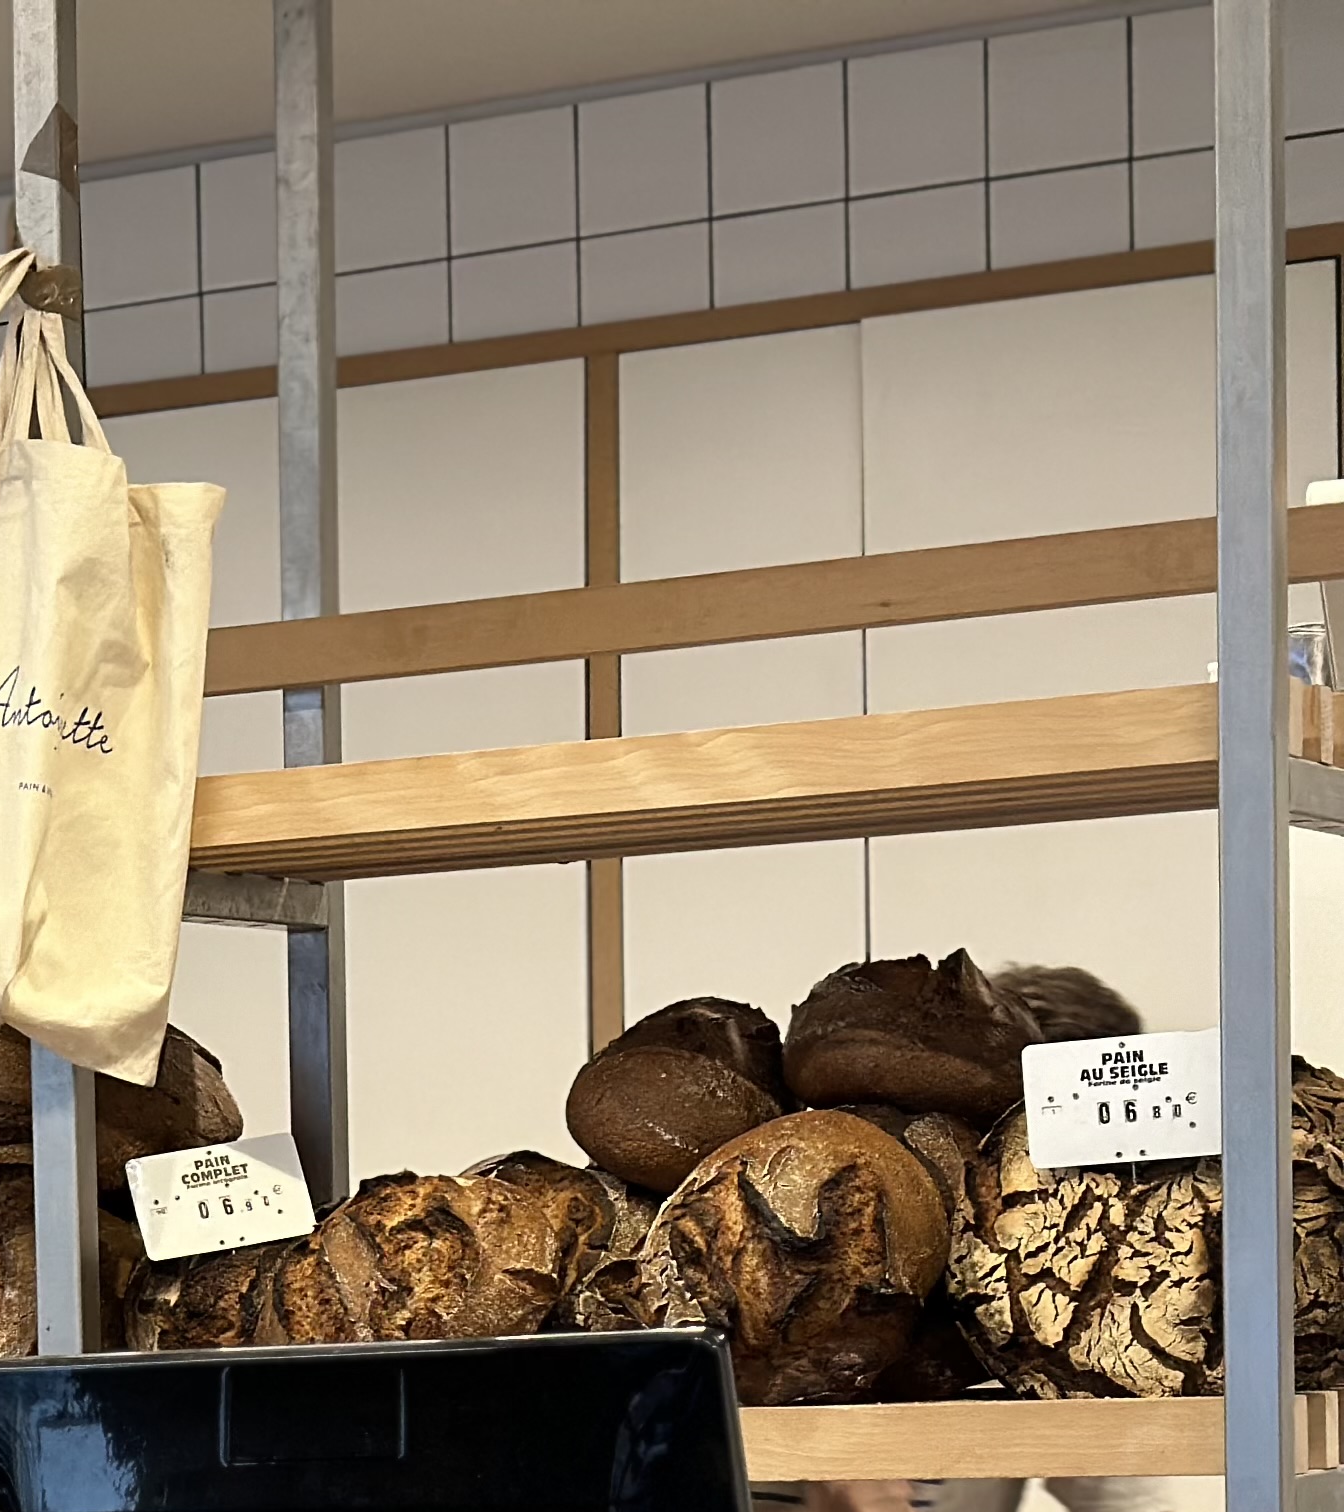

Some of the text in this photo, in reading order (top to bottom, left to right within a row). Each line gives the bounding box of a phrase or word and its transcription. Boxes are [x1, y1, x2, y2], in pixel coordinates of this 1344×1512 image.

[1101, 1050, 1144, 1065] PAIN
[1080, 1063, 1169, 1081] AU SEIGLE
[194, 1155, 230, 1170] PAIN
[181, 1163, 249, 1185] COMPLET
